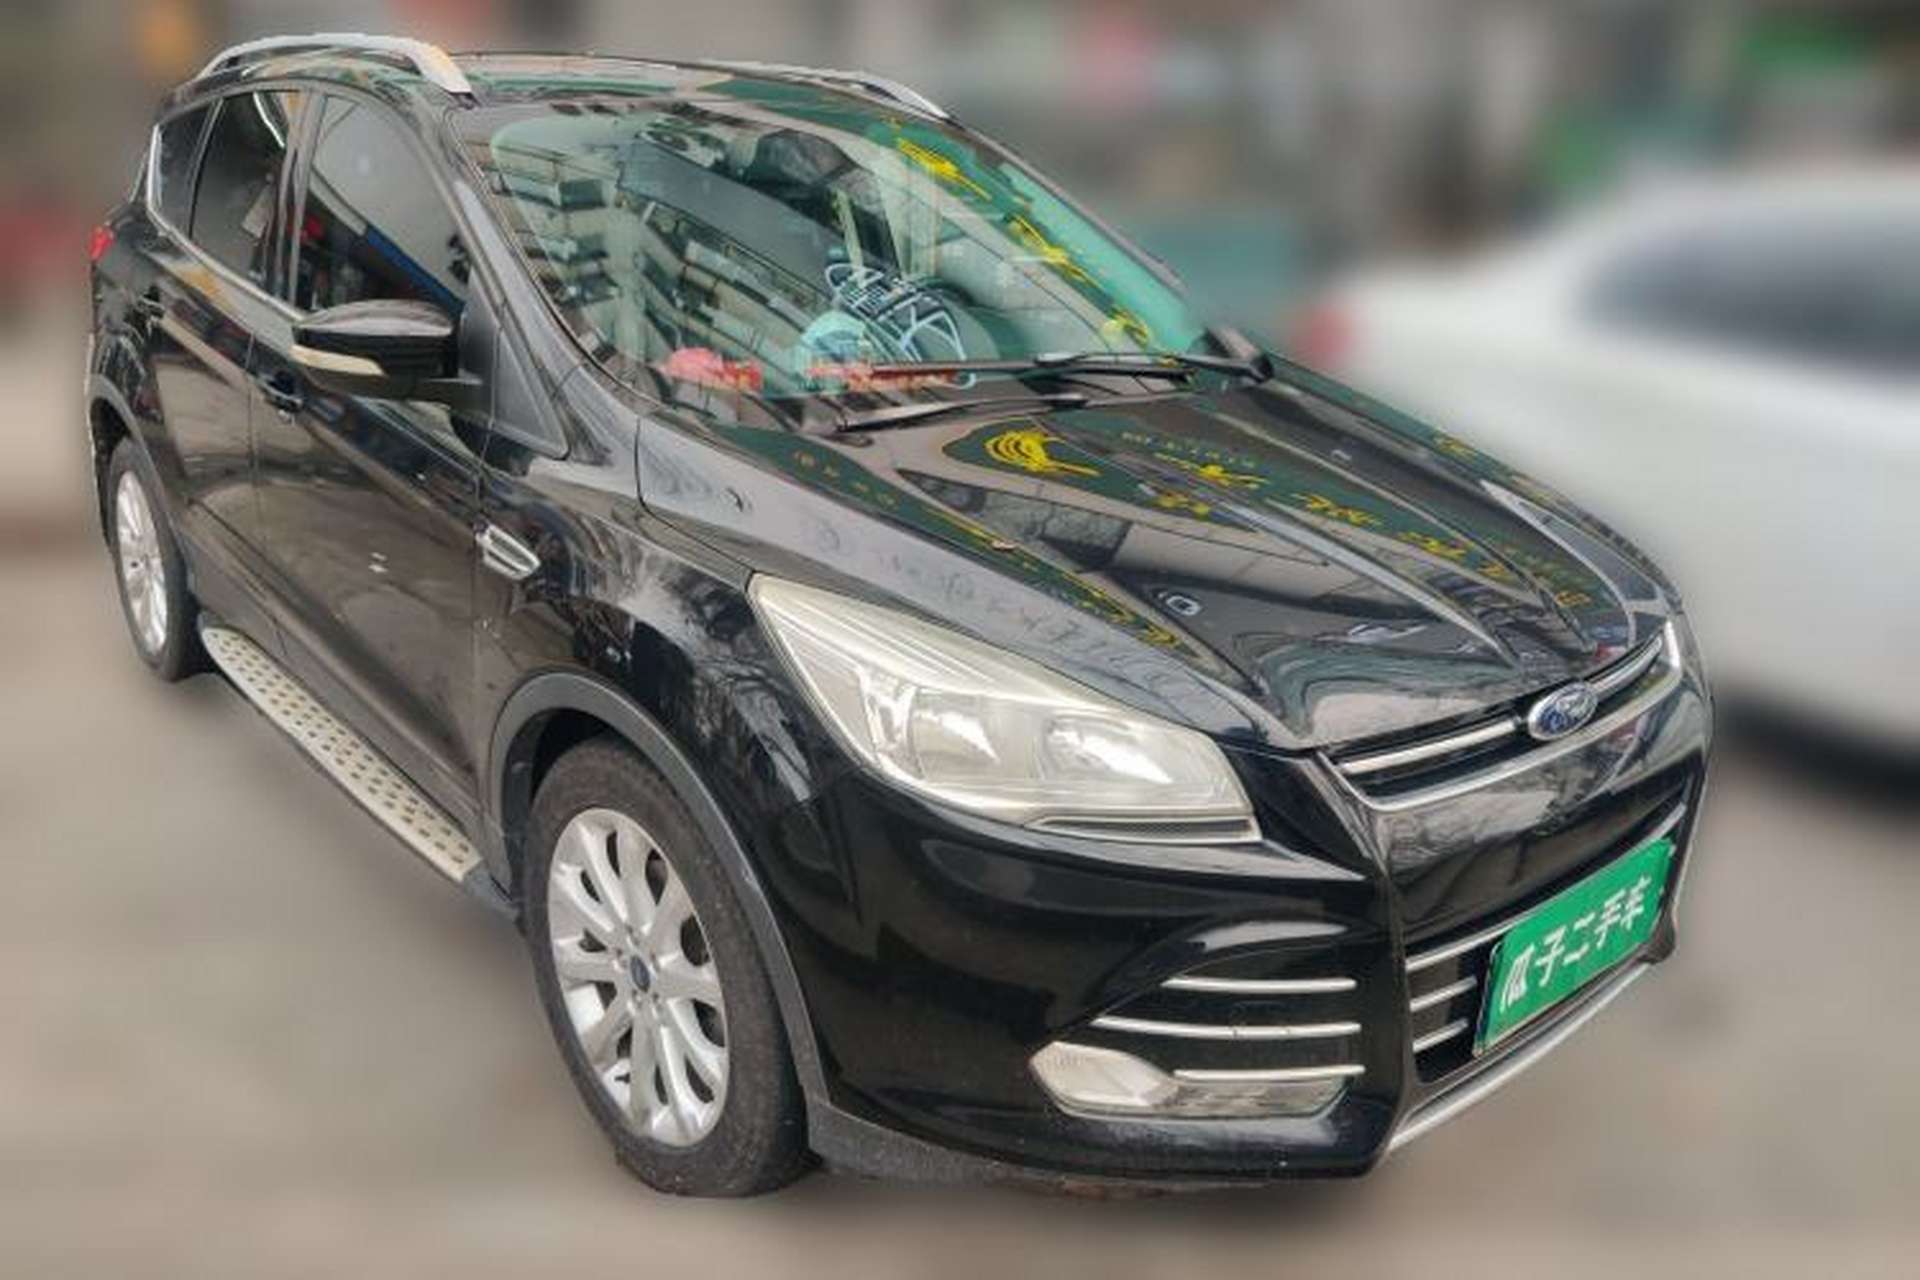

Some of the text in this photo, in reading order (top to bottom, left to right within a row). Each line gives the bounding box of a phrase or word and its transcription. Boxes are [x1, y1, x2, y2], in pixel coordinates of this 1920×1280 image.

[1499, 876, 1651, 1013] 瓜子二手车
